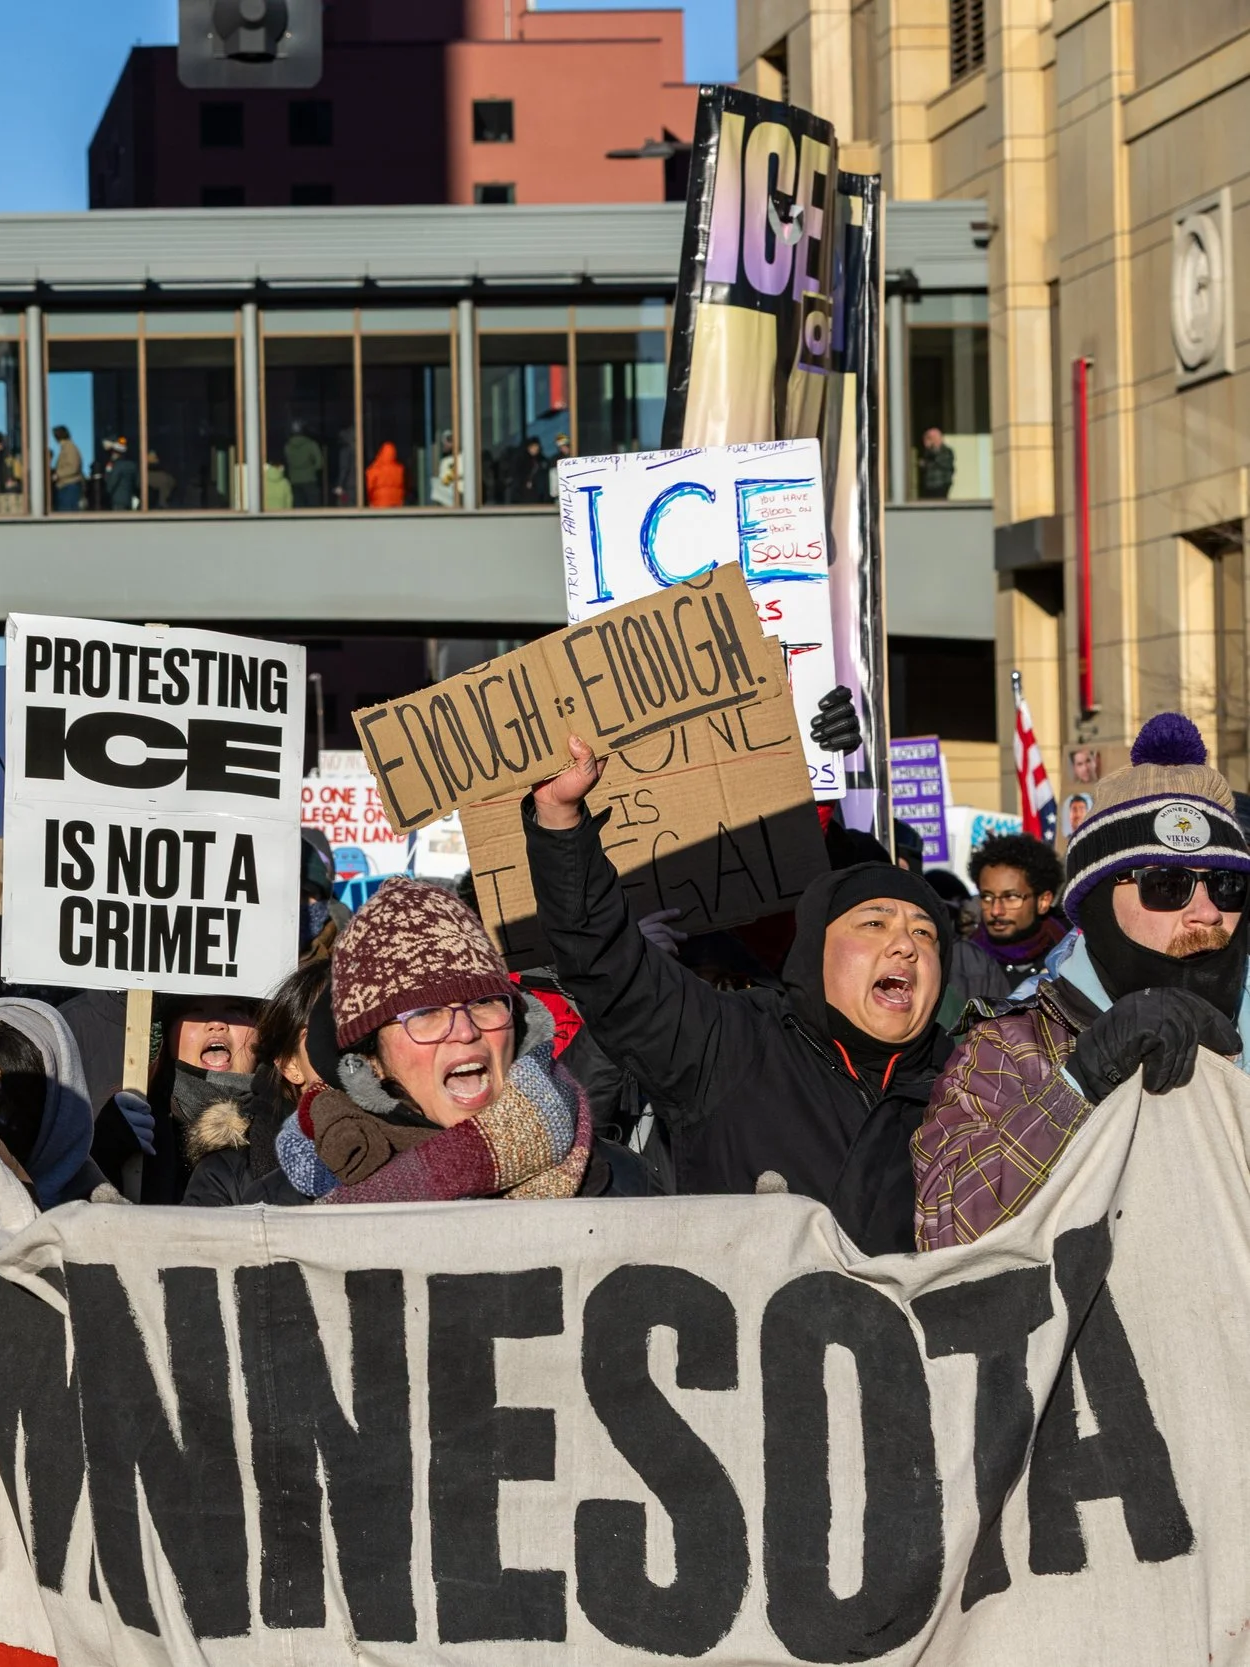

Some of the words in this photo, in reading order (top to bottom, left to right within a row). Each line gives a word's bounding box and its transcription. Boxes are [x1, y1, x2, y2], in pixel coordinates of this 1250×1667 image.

[705, 111, 830, 303] ICE
[783, 493, 808, 502] HAVE
[577, 477, 830, 604] ICE
[751, 532, 825, 563] SOULS!
[25, 635, 288, 714] PROTESTING
[24, 705, 283, 799] ICE
[360, 663, 554, 829] ENOUGH
[554, 695, 575, 718] is
[302, 786, 314, 804] O
[320, 786, 356, 805] ONE
[302, 807, 358, 825] LEGAL
[608, 788, 661, 830] IS
[1160, 806, 1202, 821] MINNESOTA
[44, 818, 95, 891] IS
[107, 824, 216, 900] NOT
[224, 832, 260, 905] A
[325, 825, 359, 843] LEN
[362, 826, 409, 844] LAND
[1166, 834, 1201, 844] VIKINGS
[475, 815, 806, 958] IGAL
[58, 896, 242, 977] CRIME!
